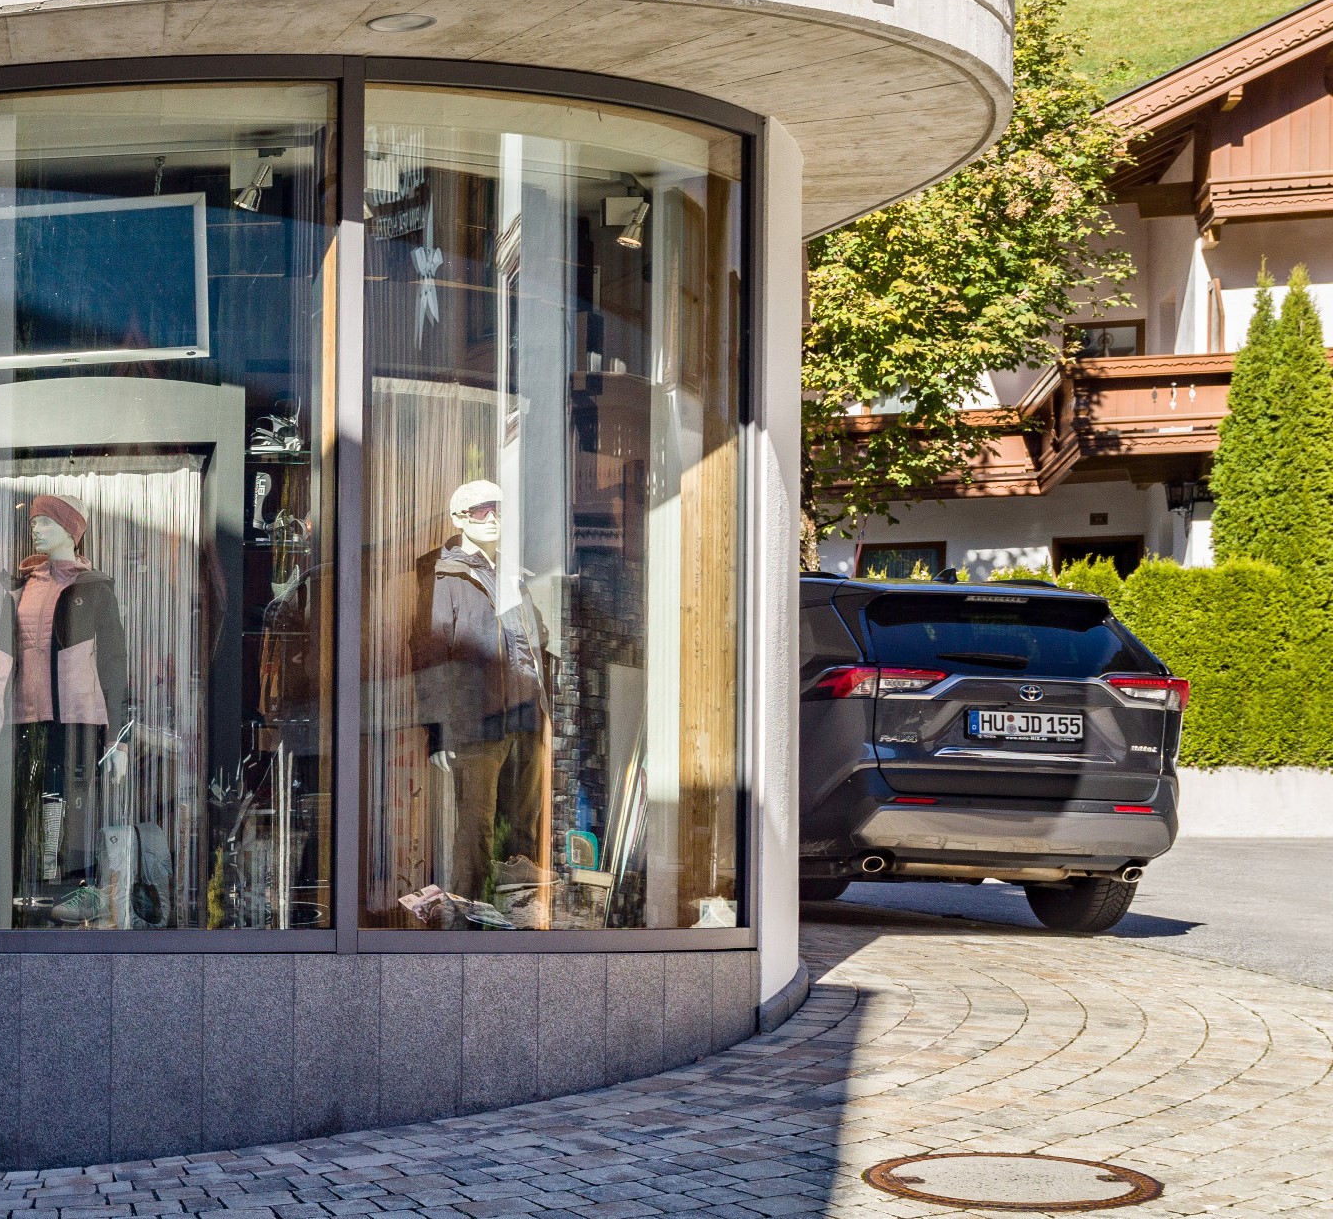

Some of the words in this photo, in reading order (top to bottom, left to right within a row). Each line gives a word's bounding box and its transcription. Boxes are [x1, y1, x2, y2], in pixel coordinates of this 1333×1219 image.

[980, 713, 1005, 732] HU
[1018, 715, 1042, 734] JD
[1047, 717, 1081, 735] 155
